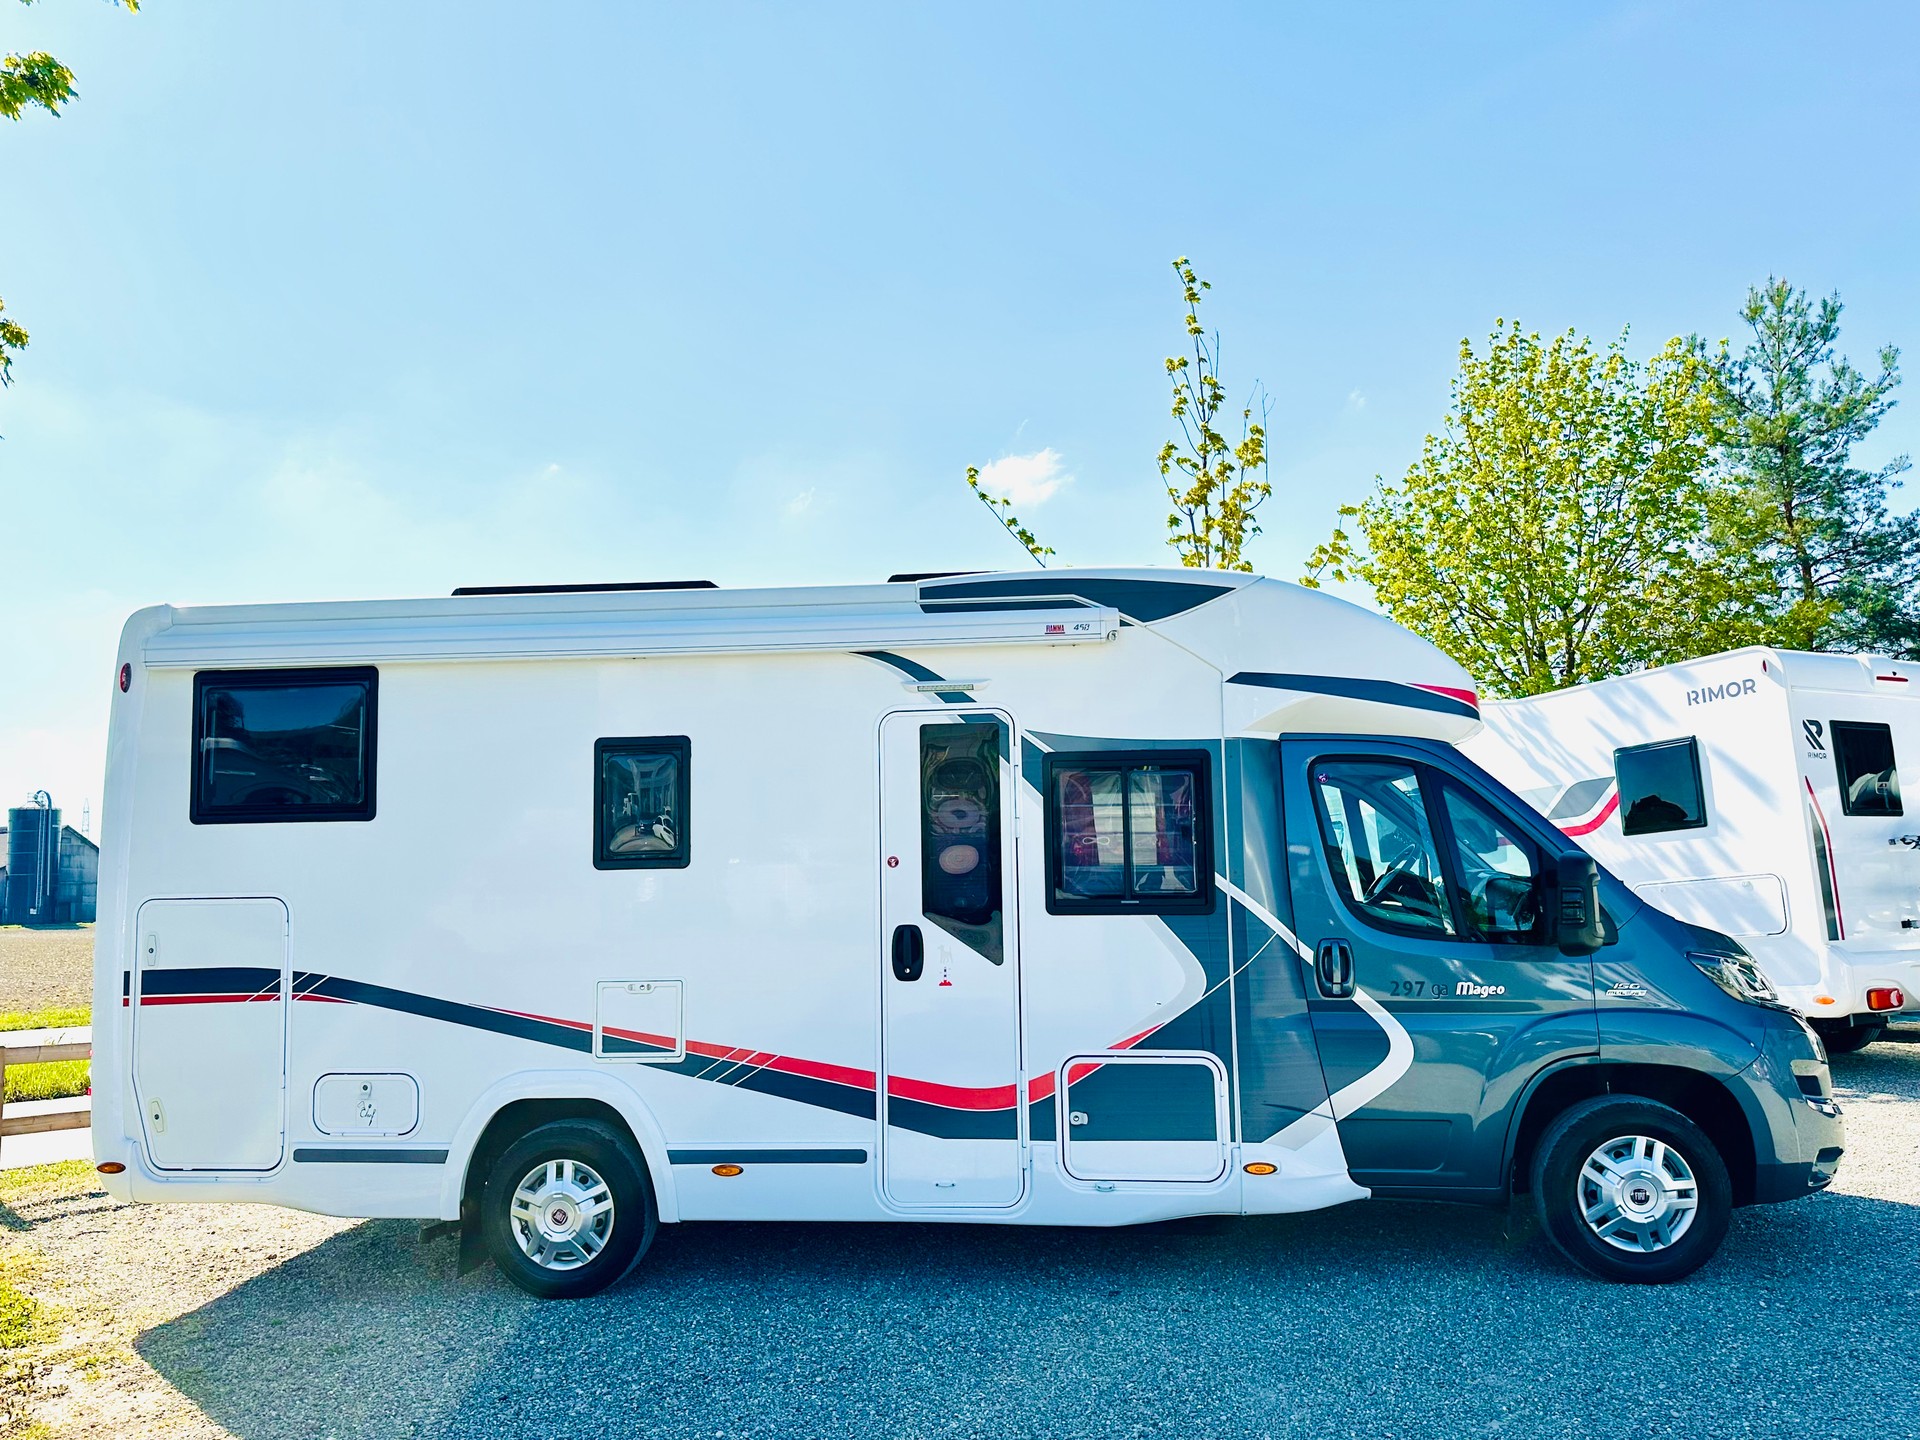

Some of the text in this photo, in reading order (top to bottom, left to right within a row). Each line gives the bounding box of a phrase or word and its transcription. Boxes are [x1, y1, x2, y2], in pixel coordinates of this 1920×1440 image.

[1045, 624, 1065, 633] FIAMMA
[1686, 678, 1757, 707] RIMOR
[1807, 752, 1828, 760] RIMOR
[1389, 980, 1506, 1000] 297 ga Mageo
